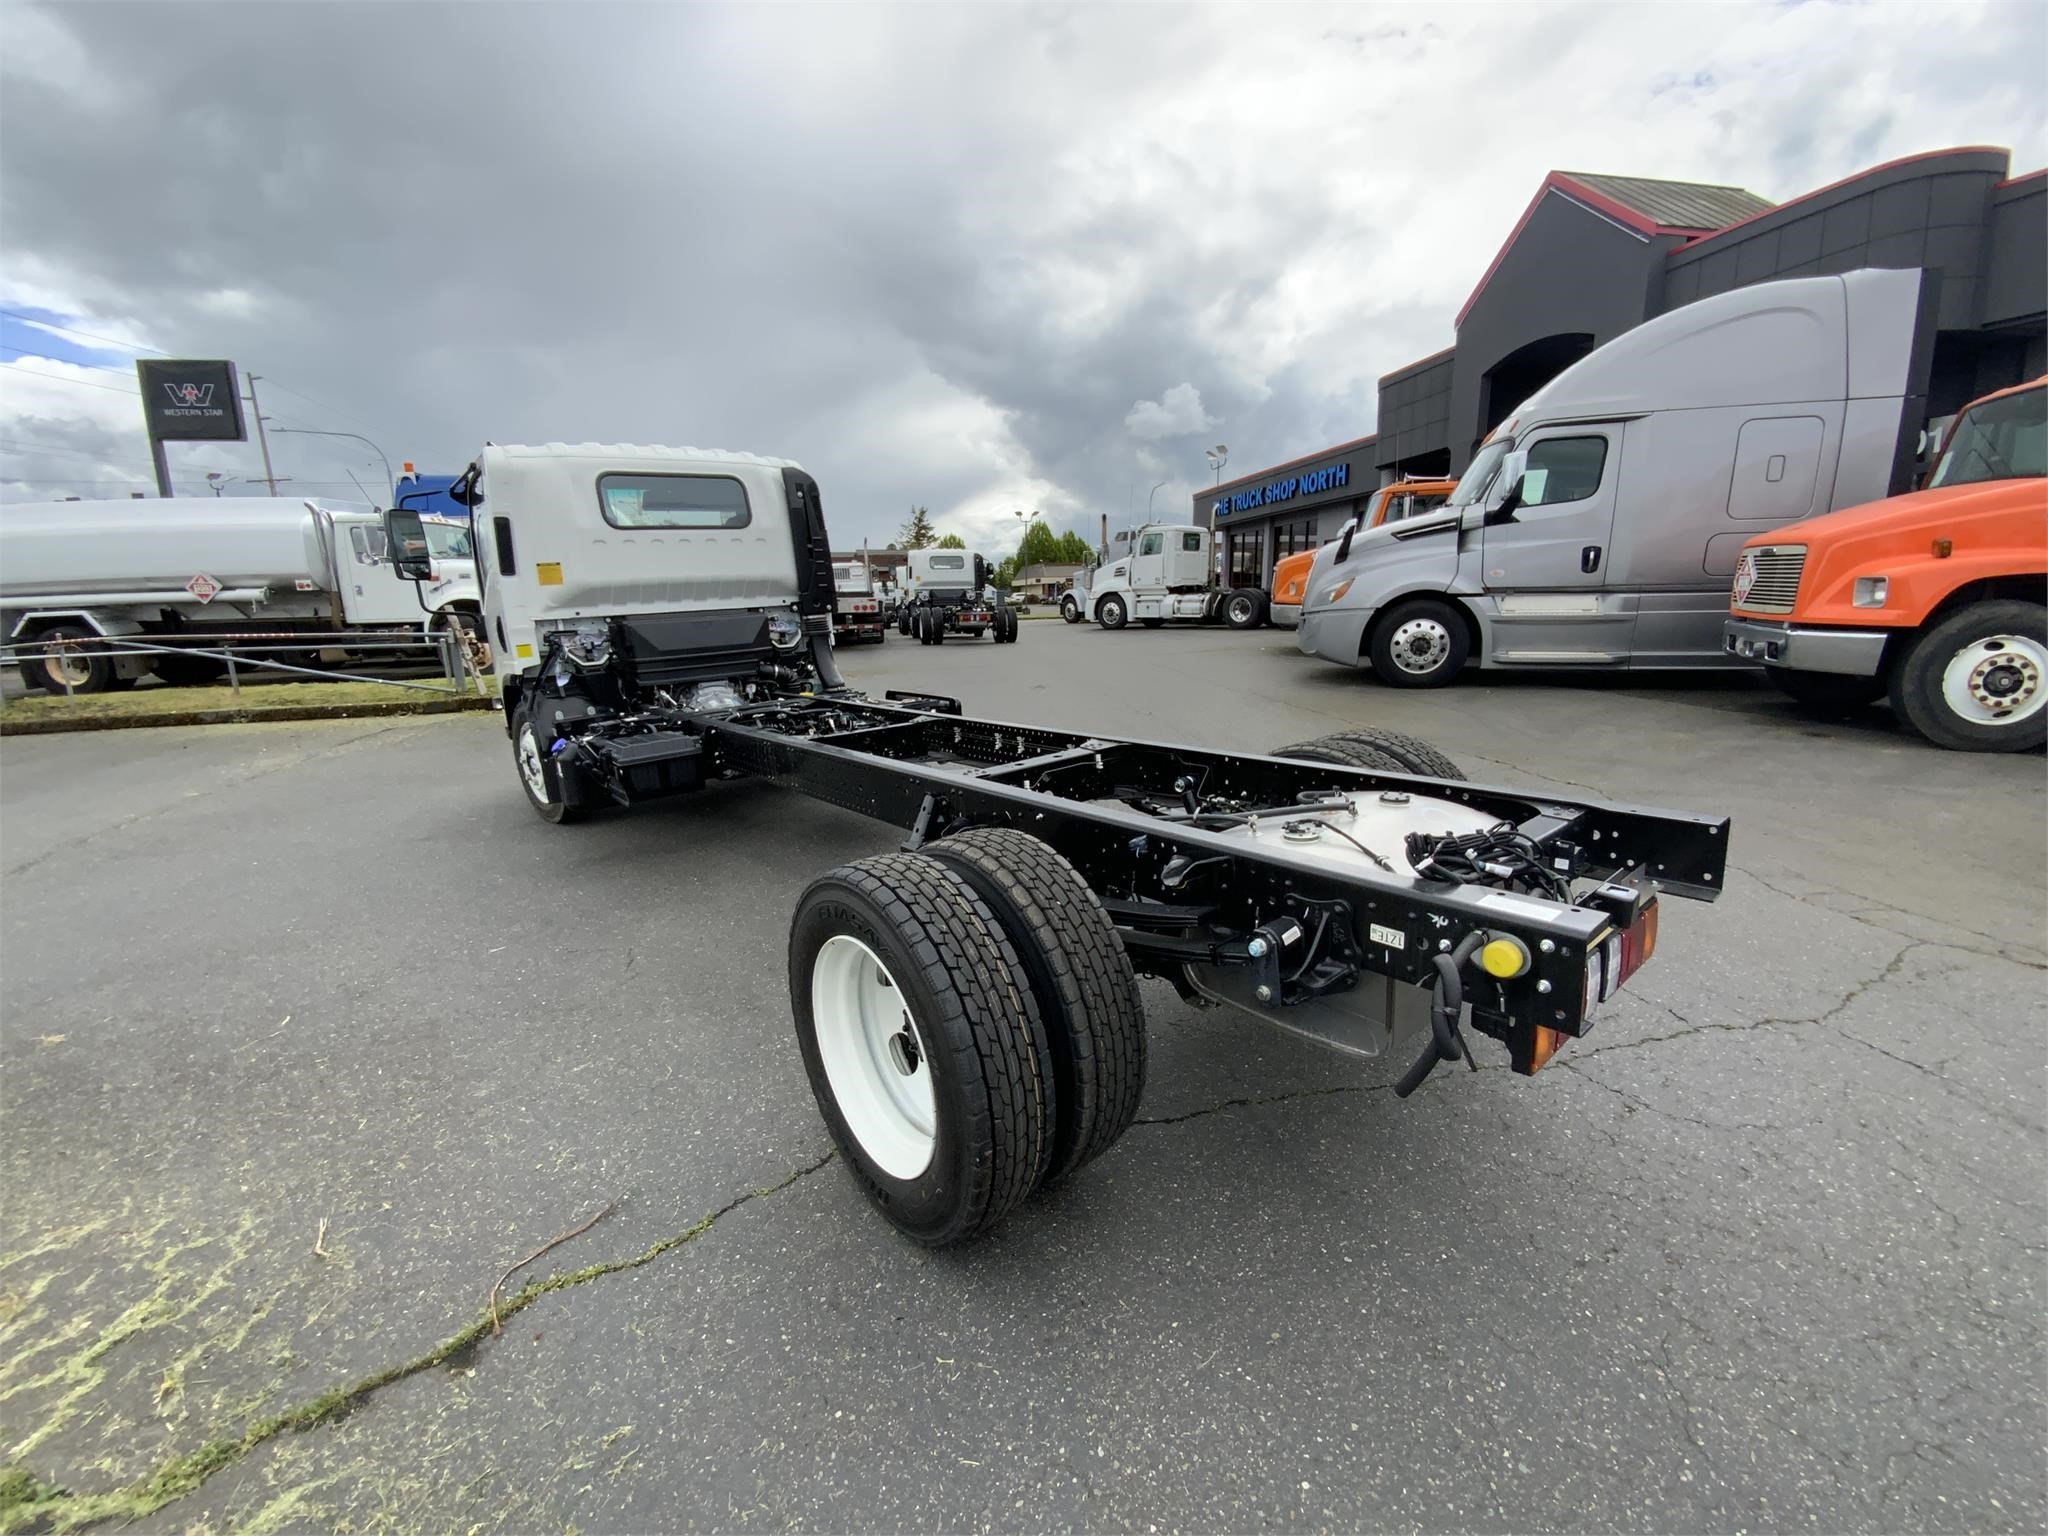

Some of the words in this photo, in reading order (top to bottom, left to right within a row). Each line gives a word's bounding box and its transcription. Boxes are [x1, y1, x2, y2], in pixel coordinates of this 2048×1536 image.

[163, 408, 201, 417] WESTERN
[203, 408, 223, 417] STAR
[1232, 486, 1264, 512] TRUCK
[1266, 479, 1297, 502] SHOP
[1300, 464, 1347, 495] NORTH
